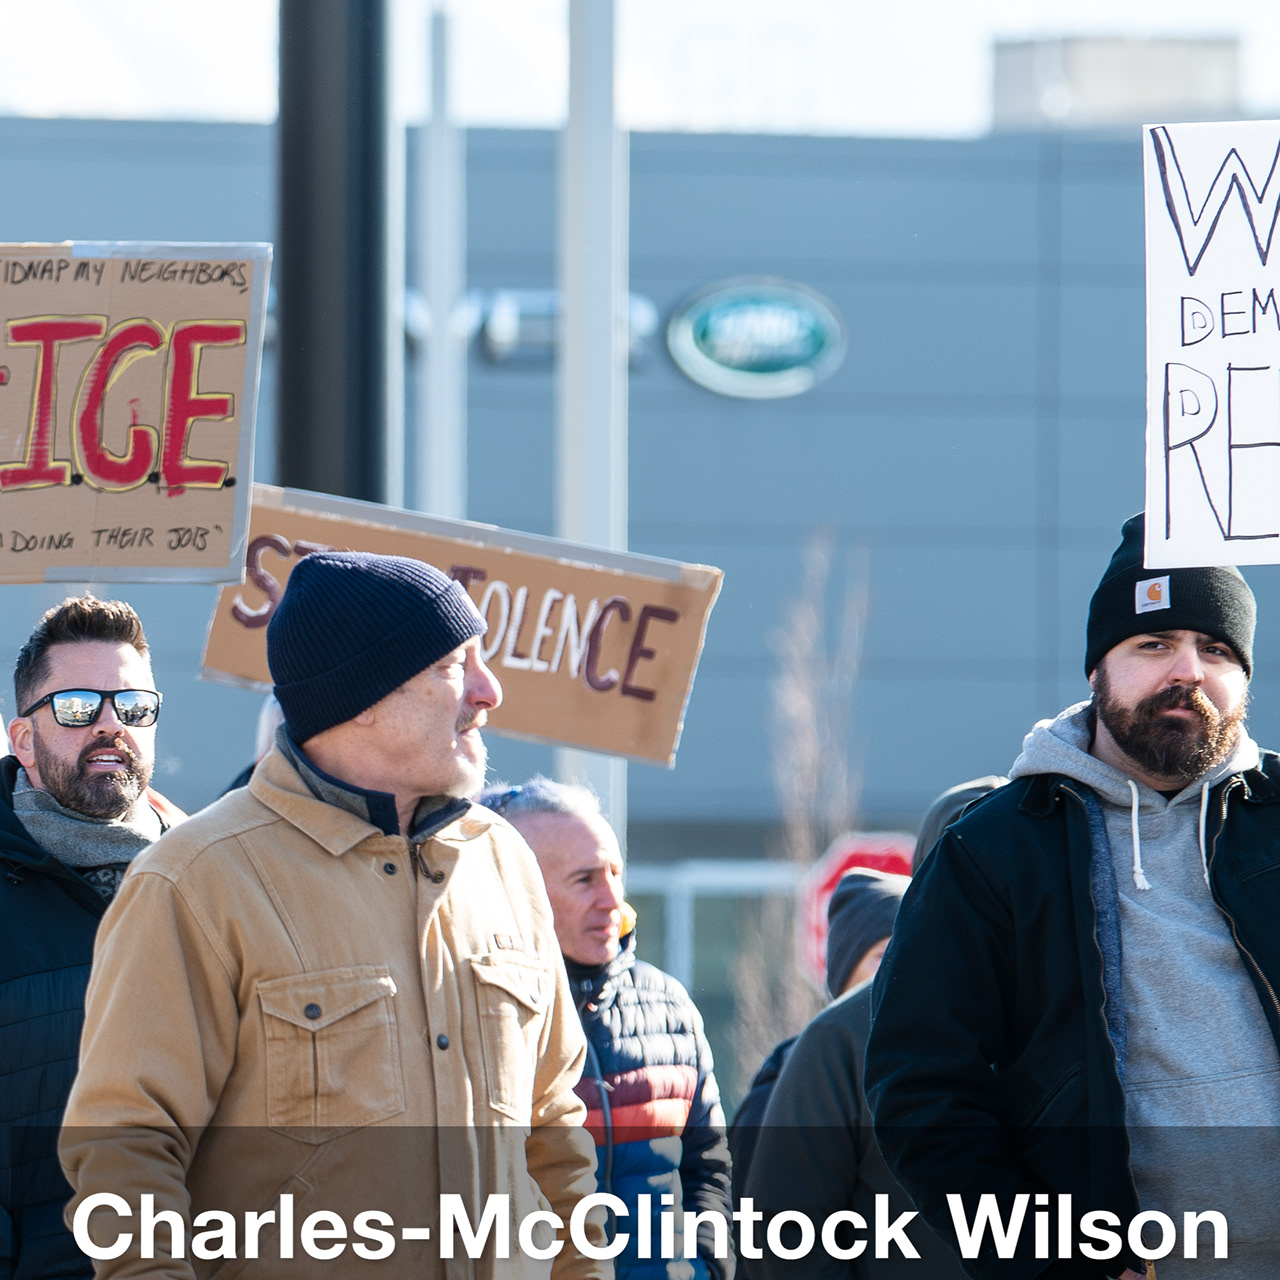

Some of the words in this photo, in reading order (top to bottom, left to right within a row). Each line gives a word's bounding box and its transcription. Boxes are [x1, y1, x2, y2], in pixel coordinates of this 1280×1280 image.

[72, 260, 106, 287] MY
[9, 530, 76, 553] DOING
[91, 526, 156, 550] THEIR
[448, 562, 681, 702] OLENCE
